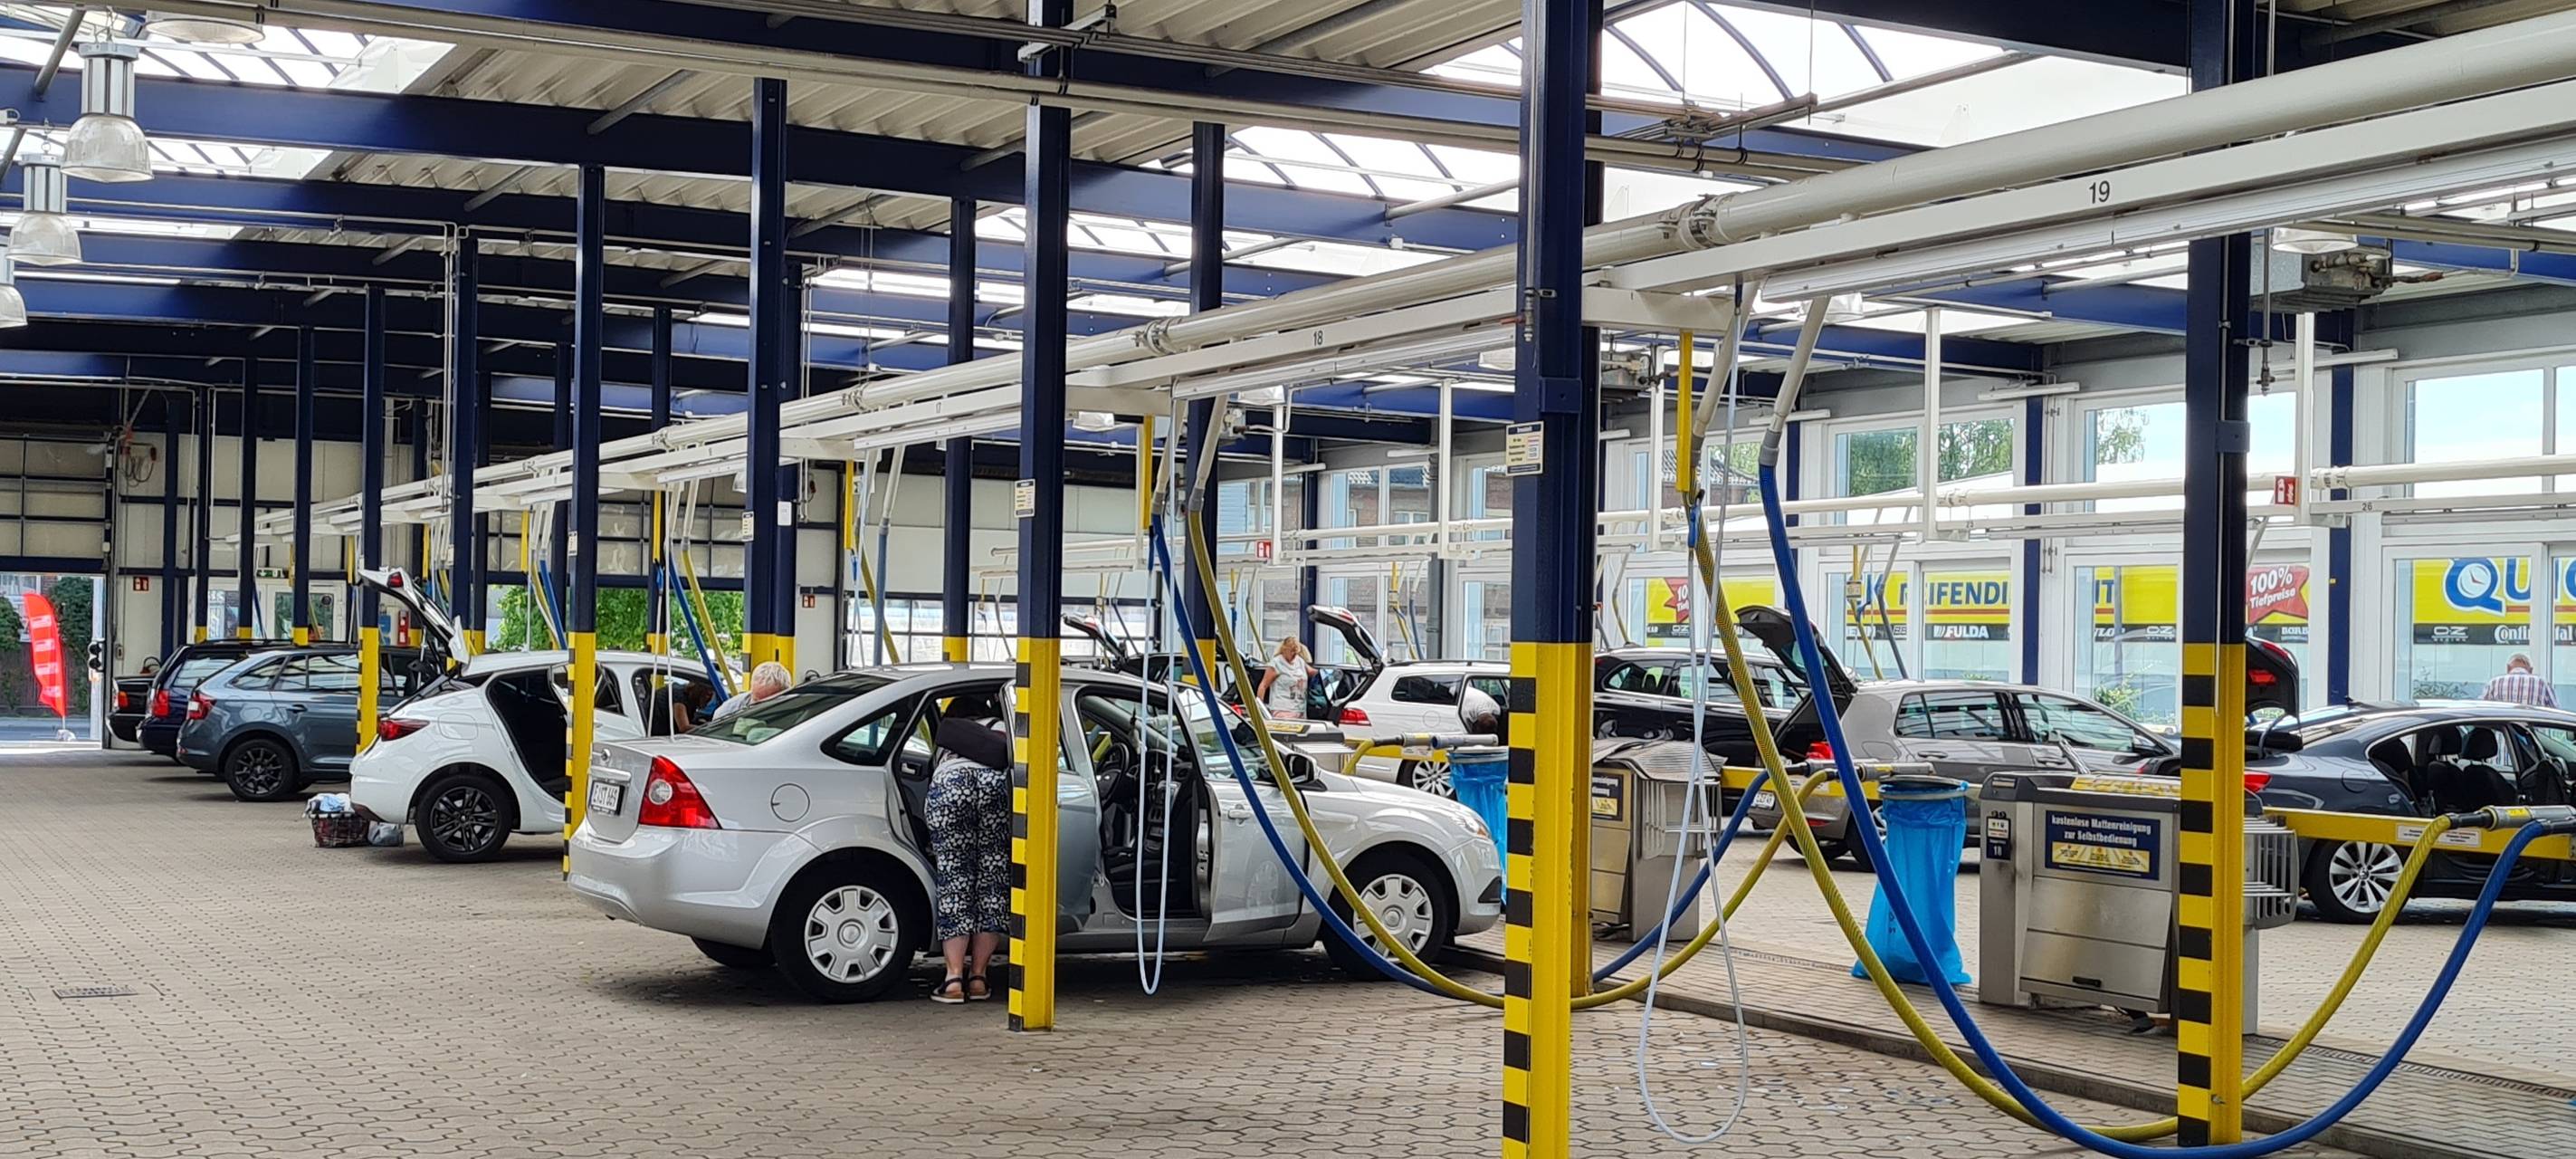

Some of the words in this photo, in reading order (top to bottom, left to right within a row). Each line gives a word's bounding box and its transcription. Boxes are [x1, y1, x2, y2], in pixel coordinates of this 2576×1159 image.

[2089, 180, 2110, 204] 19
[1313, 330, 1323, 347] 18
[2250, 565, 2294, 595] 100%
[2249, 586, 2296, 608] Tiefpreise
[1944, 626, 1989, 639] FULDA
[2051, 814, 2090, 828] kostenlose
[2091, 818, 2151, 835] Mattenreinigung
[2064, 830, 2075, 840] zur
[2077, 829, 2138, 848] Selbstbedienung
